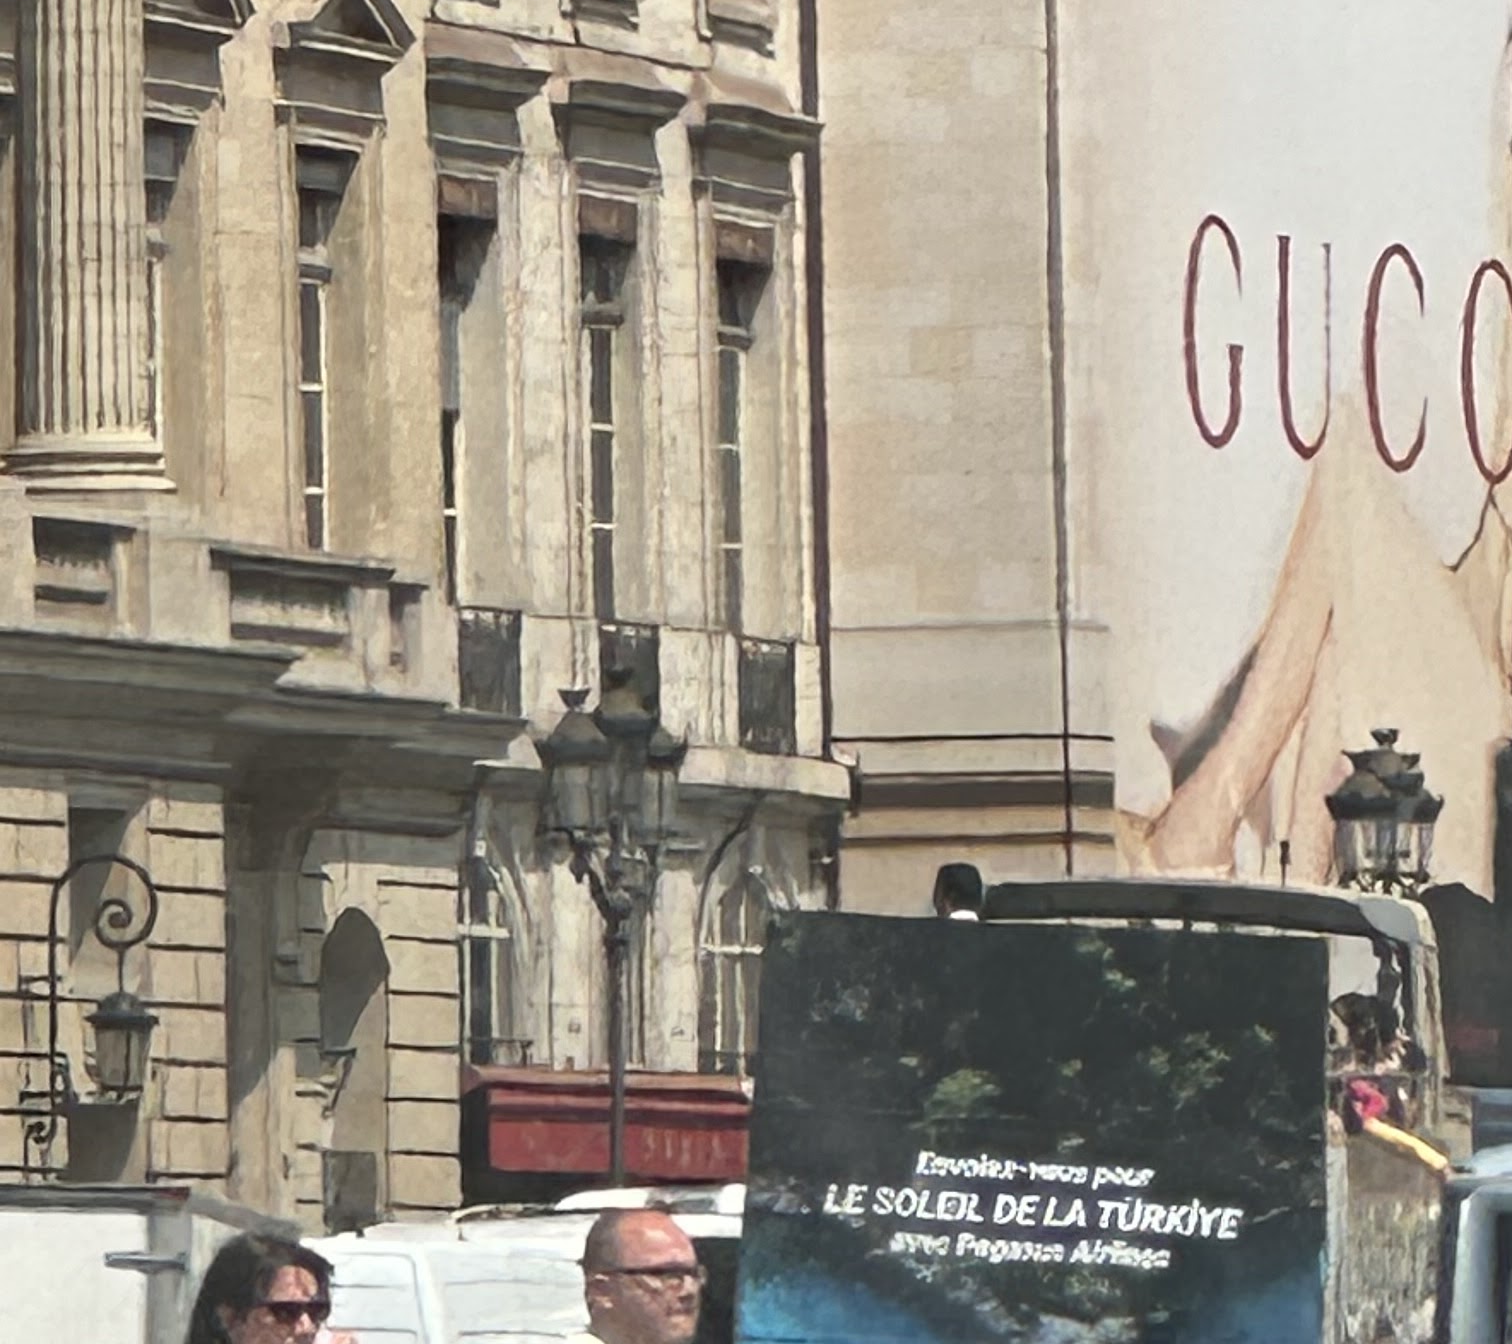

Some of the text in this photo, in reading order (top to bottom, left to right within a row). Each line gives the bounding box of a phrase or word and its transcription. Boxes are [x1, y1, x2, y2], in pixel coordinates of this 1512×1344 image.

[822, 1183, 869, 1215] LE
[992, 1192, 1041, 1227] DE
[1042, 1196, 1088, 1228] LA
